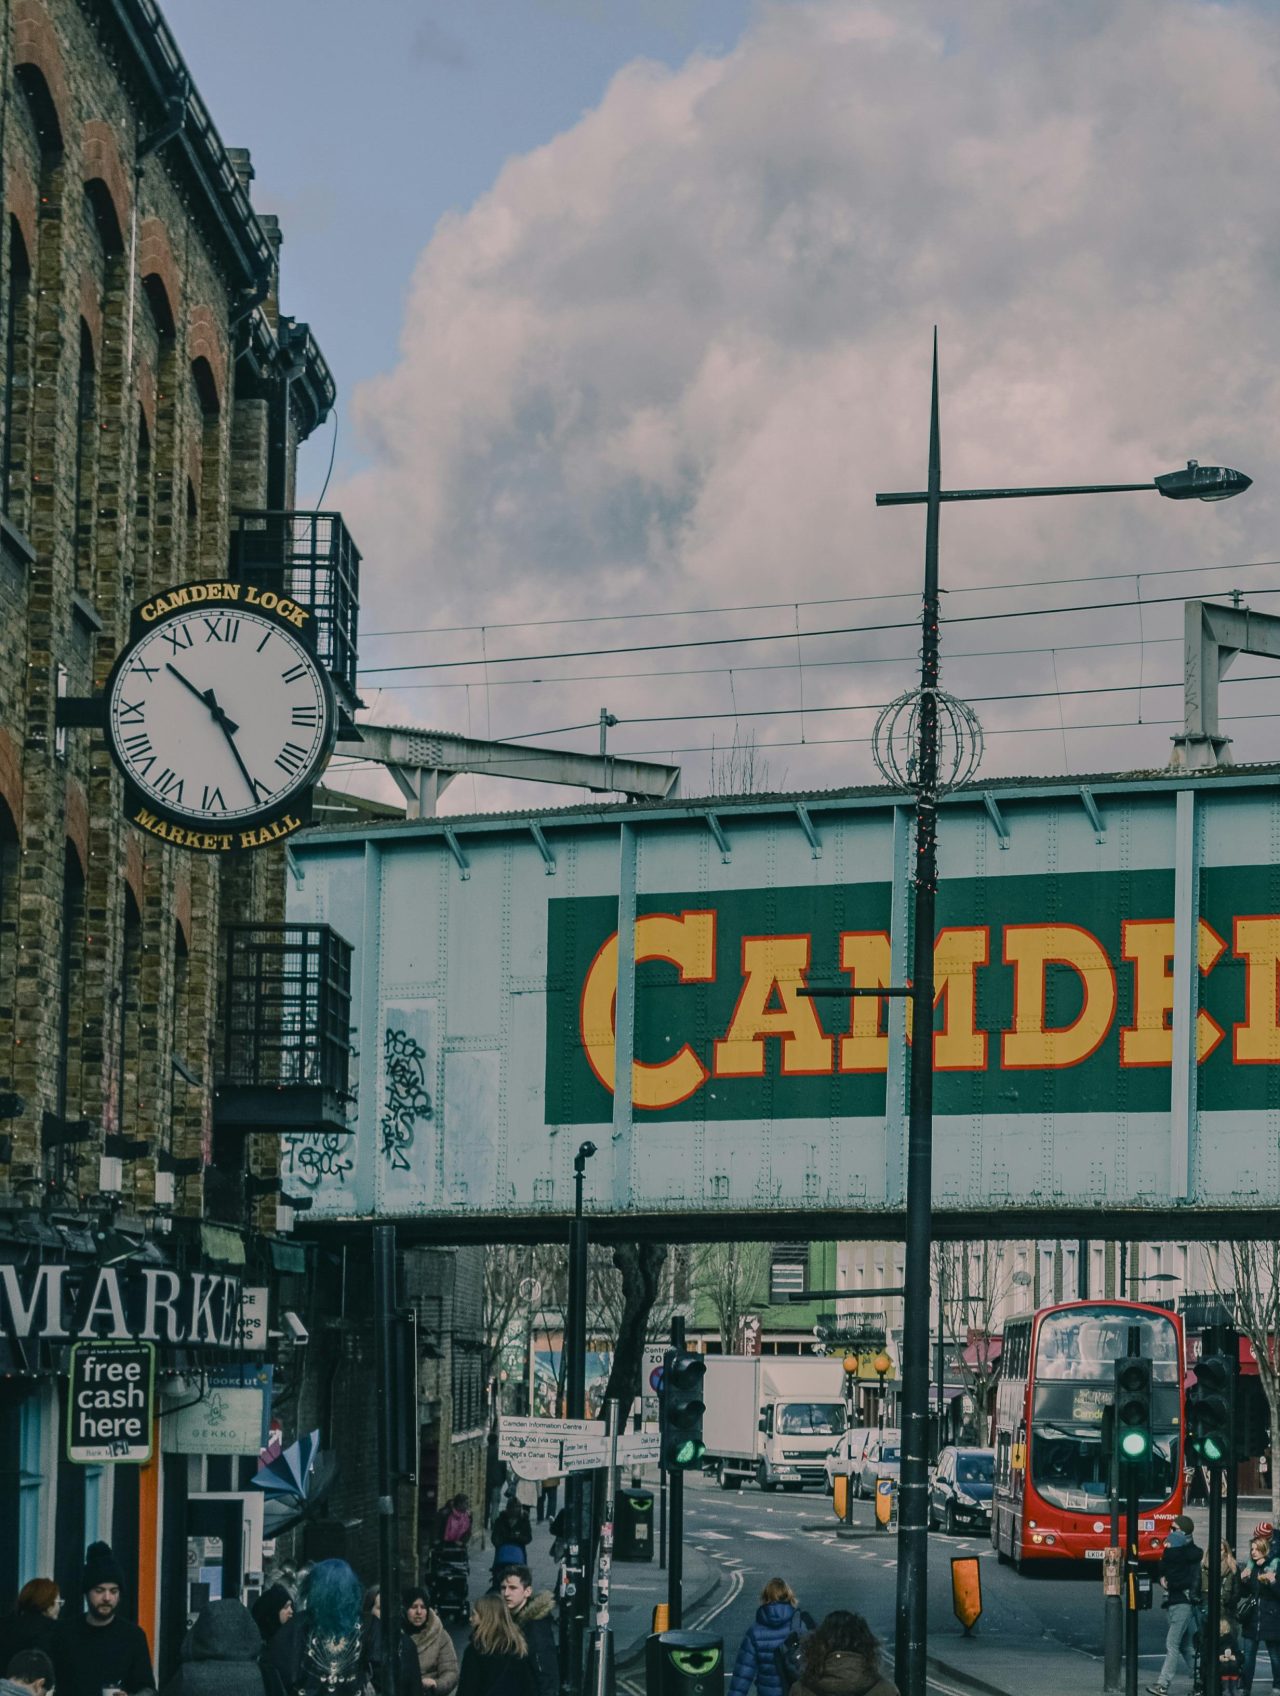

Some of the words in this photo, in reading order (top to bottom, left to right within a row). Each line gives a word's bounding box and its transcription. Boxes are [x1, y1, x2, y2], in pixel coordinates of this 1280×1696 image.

[140, 583, 241, 622] CAMDEN
[245, 586, 311, 628] LOCK
[133, 807, 234, 851] MARKET
[240, 813, 302, 849] HALL
[0, 1264, 238, 1346] MARKE
[83, 1357, 141, 1382] free
[78, 1382, 144, 1408] cash
[80, 1411, 141, 1437] here
[192, 1430, 237, 1439] GEKKO
[503, 1420, 527, 1428] Camden
[529, 1421, 561, 1429] Information
